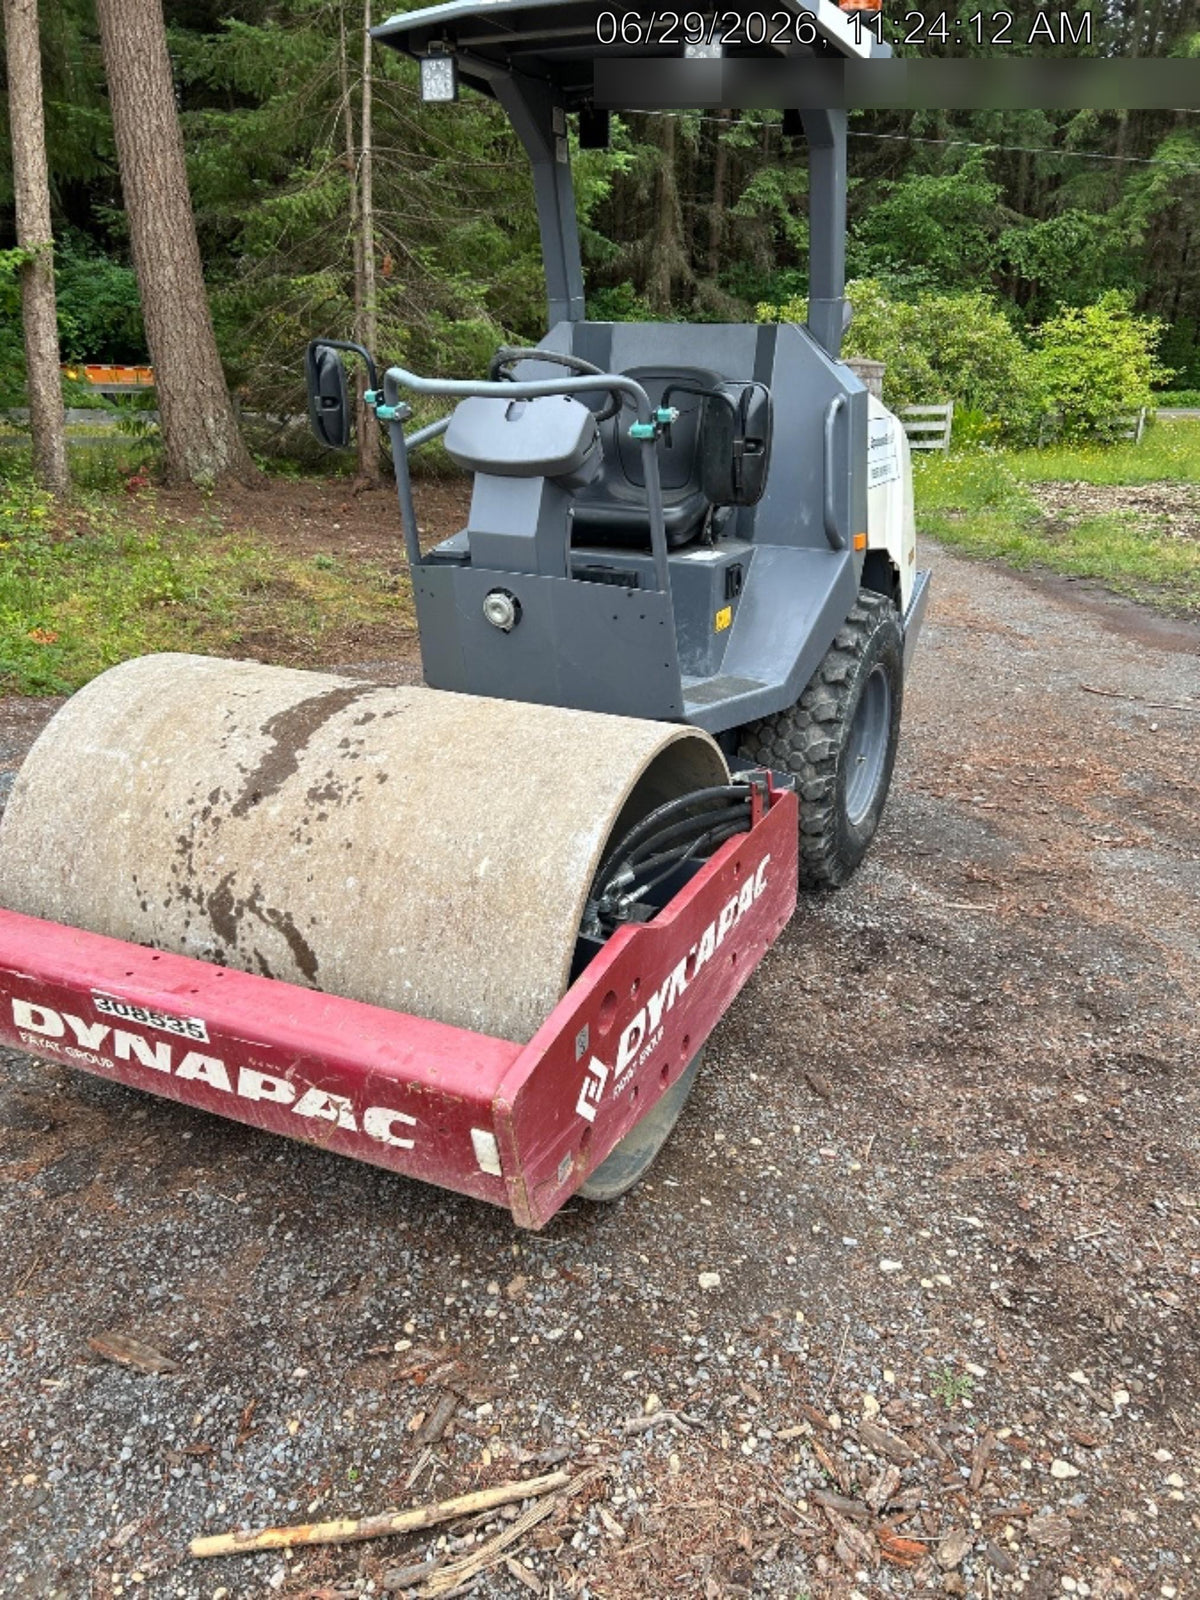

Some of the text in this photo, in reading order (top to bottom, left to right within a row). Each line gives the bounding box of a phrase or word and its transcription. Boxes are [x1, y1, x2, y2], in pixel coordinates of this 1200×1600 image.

[97, 998, 205, 1039] 308535
[11, 998, 416, 1149] DYNAPAC
[65, 1046, 114, 1069] GROUP
